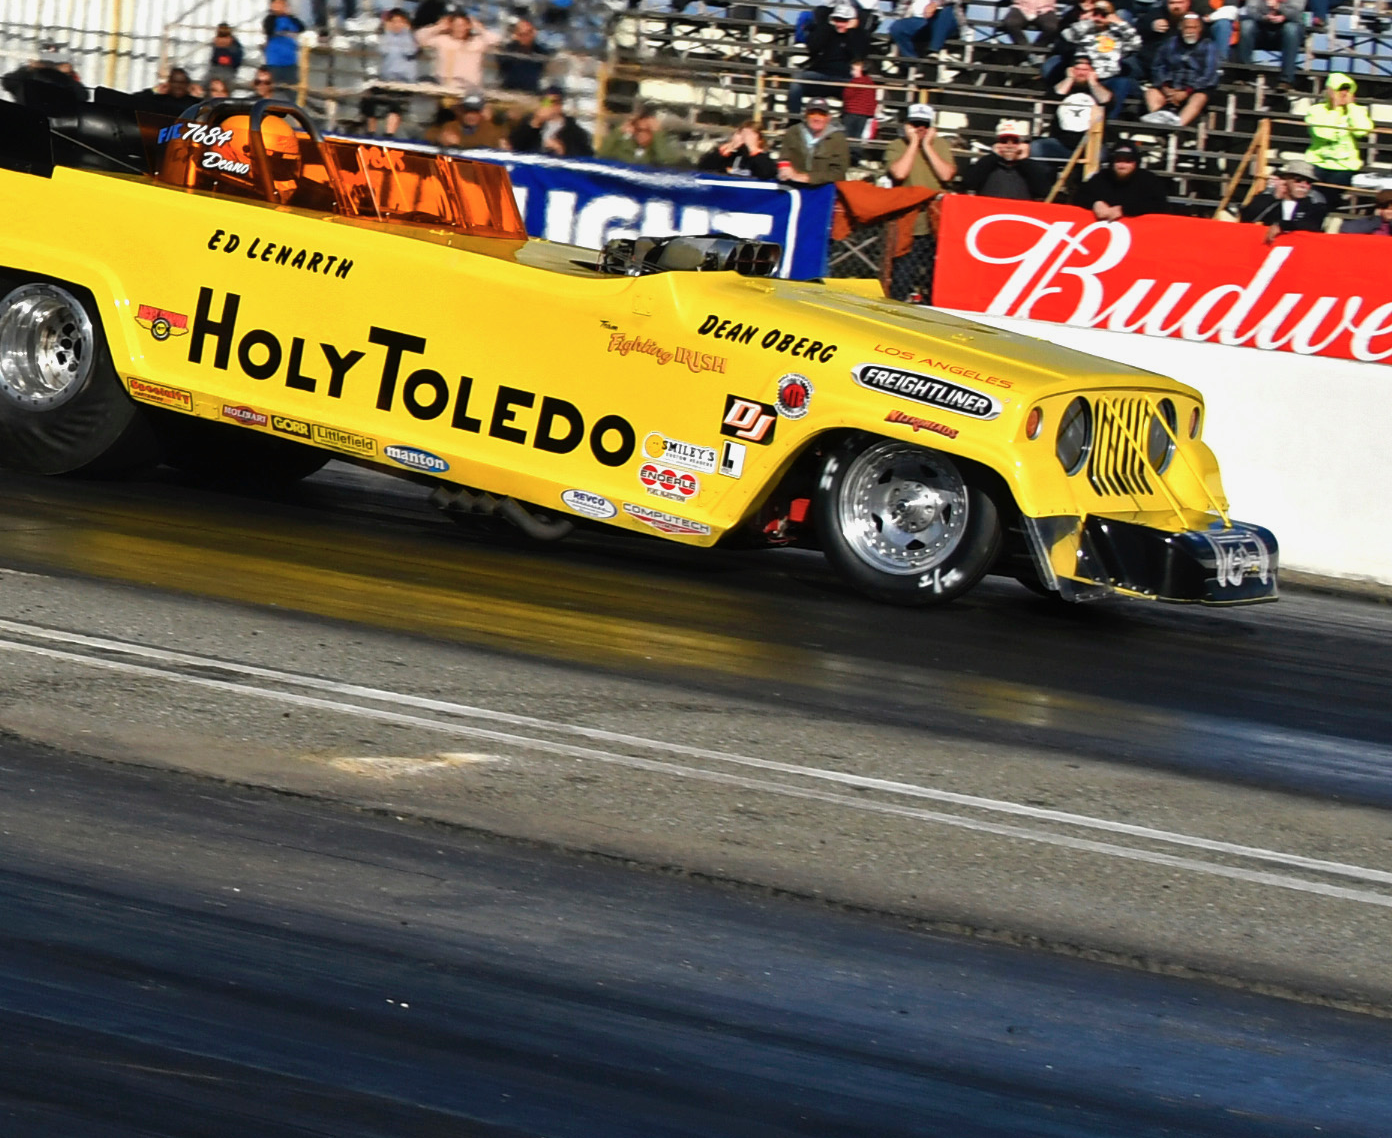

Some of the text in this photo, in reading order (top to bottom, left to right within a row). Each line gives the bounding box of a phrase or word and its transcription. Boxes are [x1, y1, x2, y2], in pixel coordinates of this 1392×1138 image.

[182, 122, 233, 148] 7684
[202, 151, 251, 176] Deano
[207, 229, 355, 280] ED LENARTH
[697, 314, 838, 363] DEAN OBERG
[607, 332, 728, 374] Fighting IRISH
[874, 344, 1015, 389] LOS ANGELES
[188, 286, 637, 468] HOLY TOLEDO
[863, 367, 989, 414] FREIGHTLINER
[273, 416, 310, 436] GORR
[723, 398, 776, 442] DJ
[316, 426, 374, 451] Littlefield
[662, 439, 715, 462] SMILEY'S
[385, 445, 446, 471] manton
[640, 469, 696, 490] ENDERLE
[573, 491, 606, 507] REVCO
[623, 503, 710, 533] COMPUTECH
